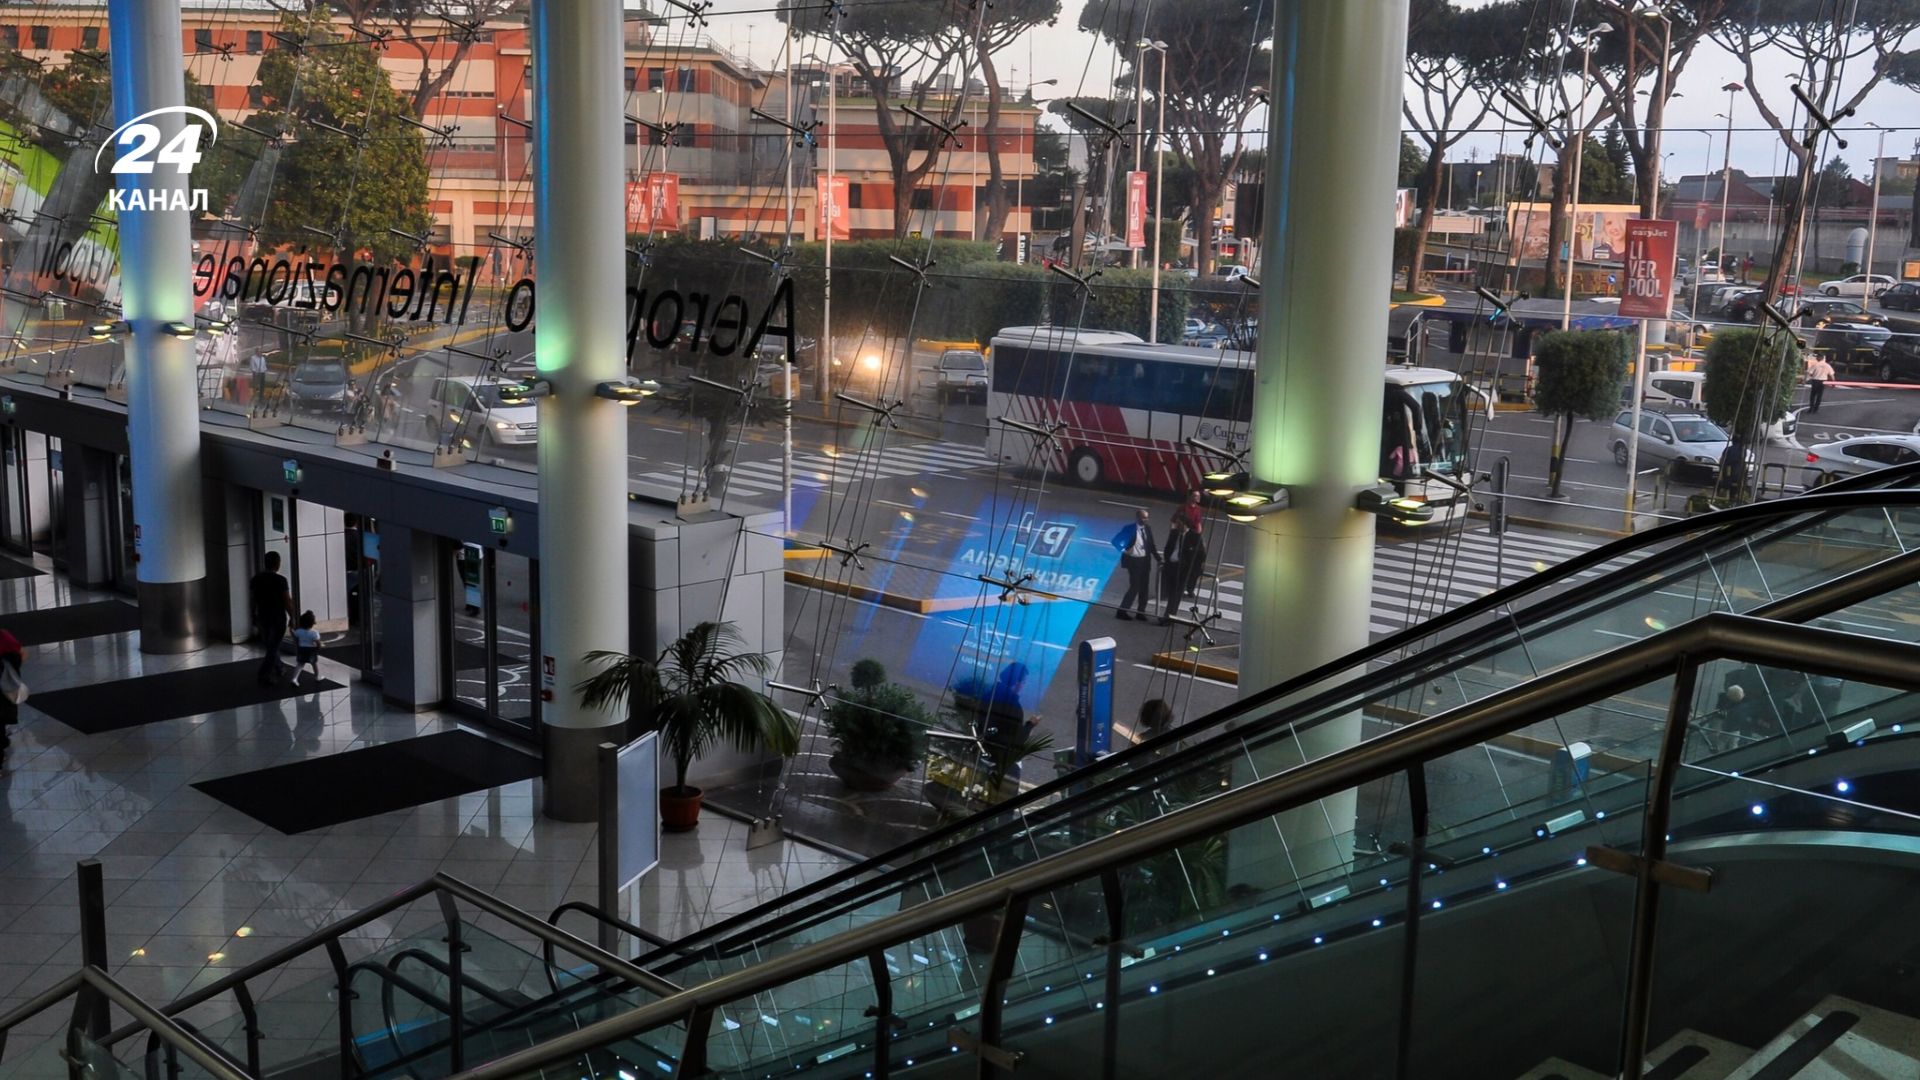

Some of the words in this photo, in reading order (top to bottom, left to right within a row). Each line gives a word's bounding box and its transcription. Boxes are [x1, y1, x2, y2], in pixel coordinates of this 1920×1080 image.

[1632, 228, 1669, 238] easyJet
[1629, 241, 1644, 260] LI
[1628, 260, 1657, 278] VER
[1627, 277, 1663, 298] POOL
